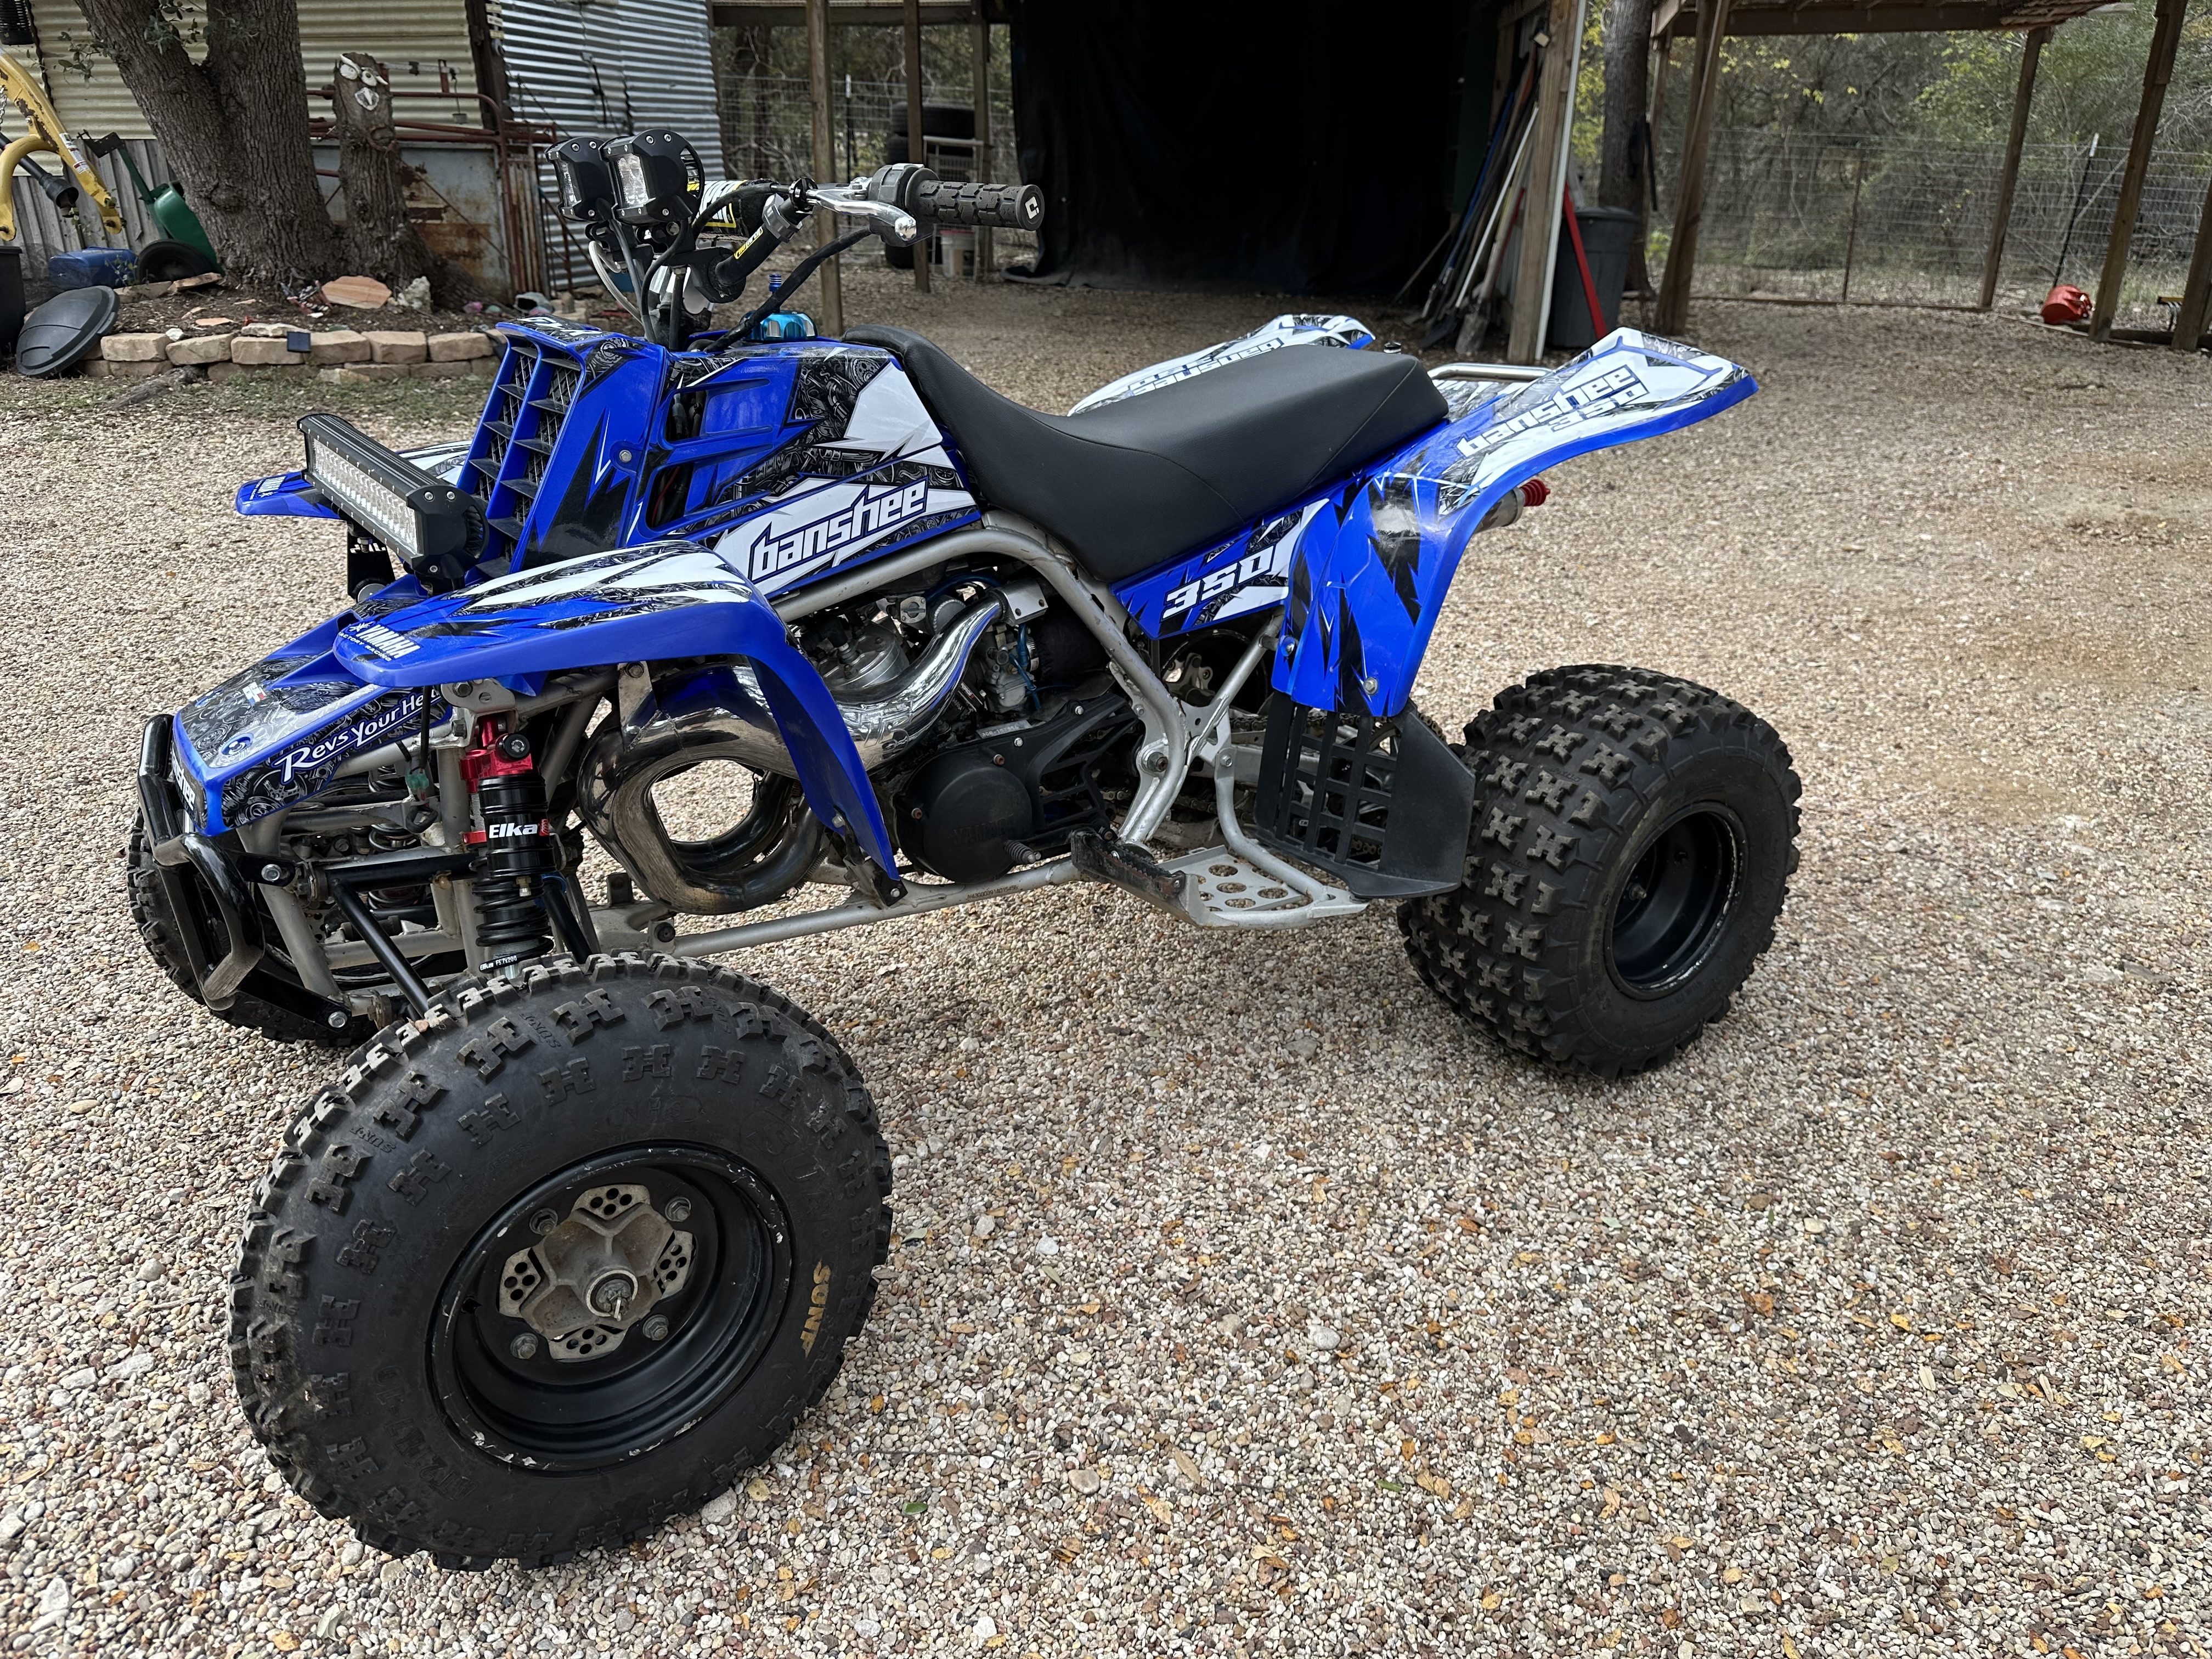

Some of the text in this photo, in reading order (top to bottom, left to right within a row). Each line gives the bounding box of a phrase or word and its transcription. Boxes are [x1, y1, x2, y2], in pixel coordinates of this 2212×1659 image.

[1456, 366, 1637, 457] banshee
[1550, 381, 1648, 431] 350
[752, 482, 926, 580] banshee
[1163, 546, 1275, 620] 350
[356, 624, 420, 658] YAMAHA
[365, 645, 392, 661] RACING
[274, 733, 349, 782] Revs
[352, 708, 400, 747] Your
[489, 823, 538, 838] Elka
